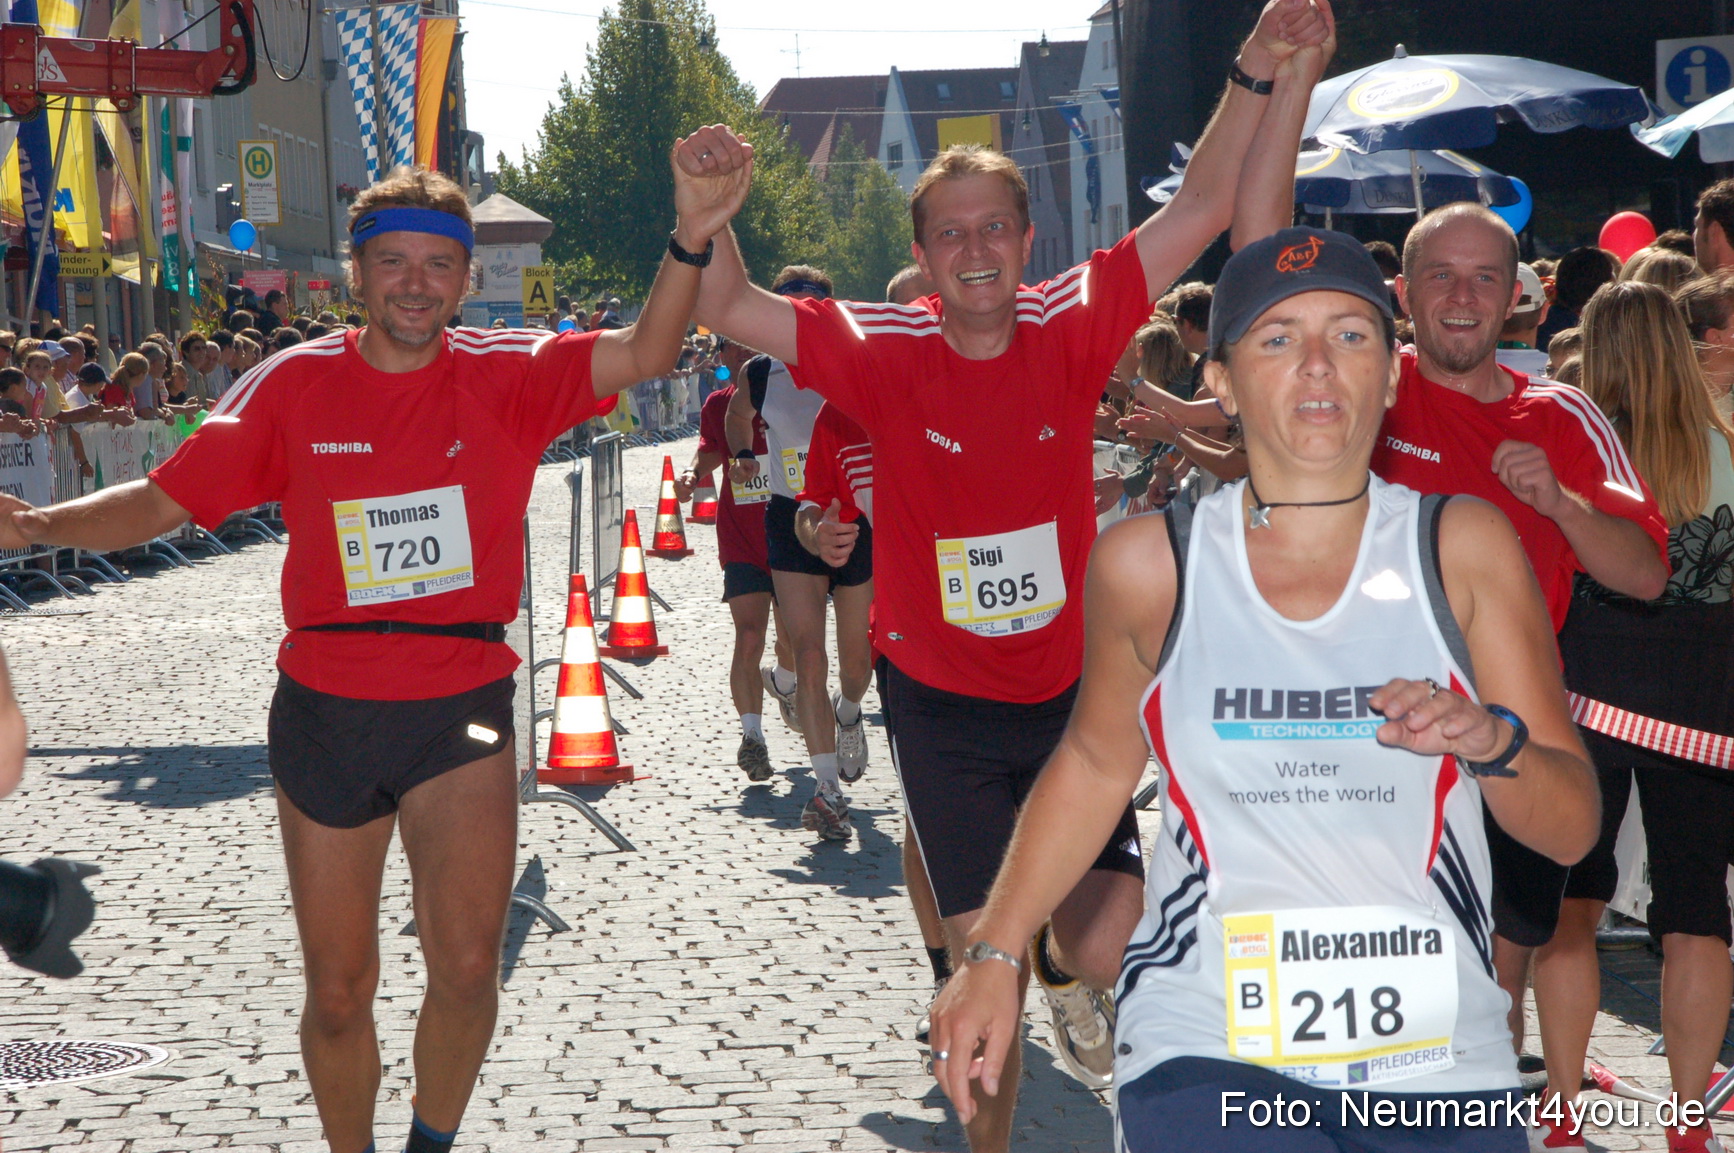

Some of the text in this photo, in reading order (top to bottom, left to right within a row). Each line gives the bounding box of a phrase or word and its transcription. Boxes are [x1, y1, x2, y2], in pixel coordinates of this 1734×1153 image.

[252, 154, 266, 172] H
[60, 255, 92, 264] inder-
[525, 267, 551, 278] Block
[529, 280, 548, 304] A
[311, 442, 373, 454] TOSHIBA
[1386, 436, 1441, 463] TOSHIBA
[788, 467, 796, 476] D
[366, 503, 440, 528] Thomas
[346, 540, 361, 557] B
[375, 536, 441, 573] 720
[968, 545, 1004, 567] Sigi
[426, 572, 472, 588] PFLEIDERER
[948, 577, 962, 594] B
[977, 572, 1039, 609] 695
[1275, 761, 1341, 778] Water
[1228, 785, 1396, 804] moves the world
[1281, 924, 1443, 962] Alexandra
[1240, 982, 1264, 1010] B
[1290, 986, 1405, 1042] 218
[1370, 1046, 1450, 1073] PFLEIDERER
